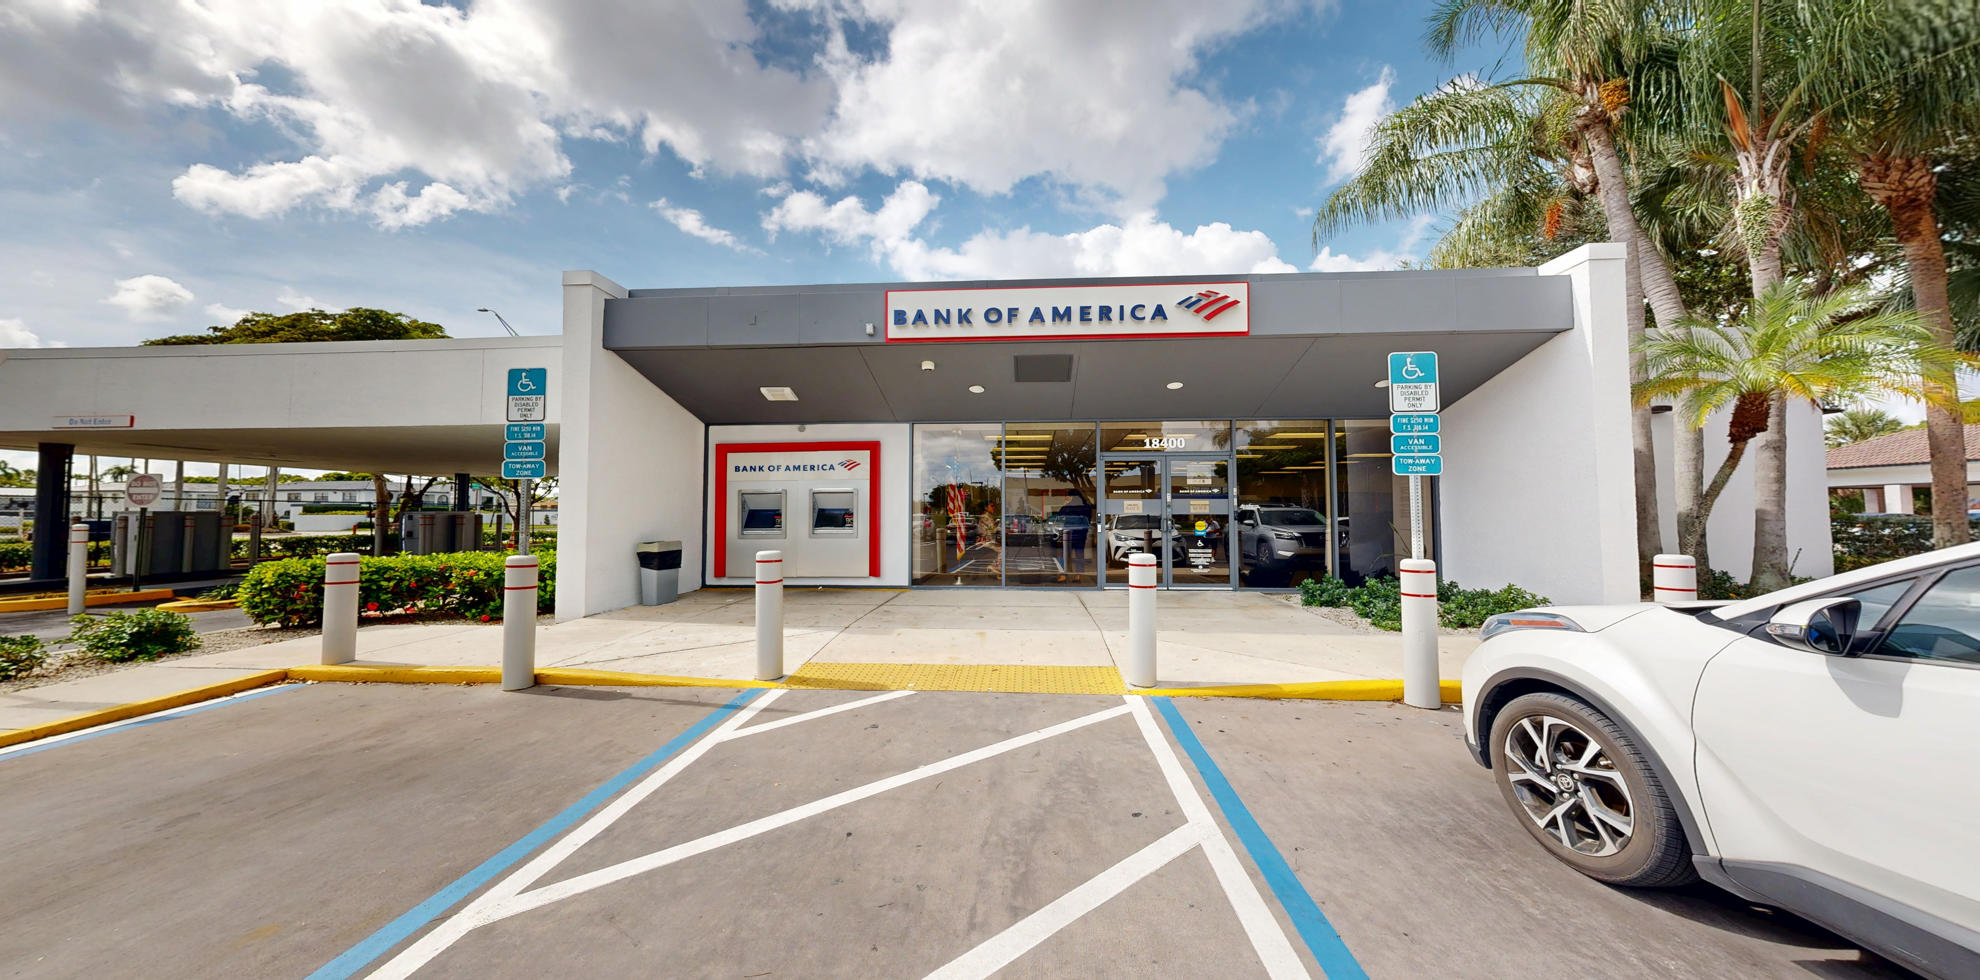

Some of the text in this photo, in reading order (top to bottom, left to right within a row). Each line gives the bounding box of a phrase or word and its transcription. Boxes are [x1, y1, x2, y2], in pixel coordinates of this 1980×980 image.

[893, 303, 1169, 326] BANK OF AMERICA
[1143, 438, 1185, 448] 18400
[784, 463, 836, 471] AMERICA
